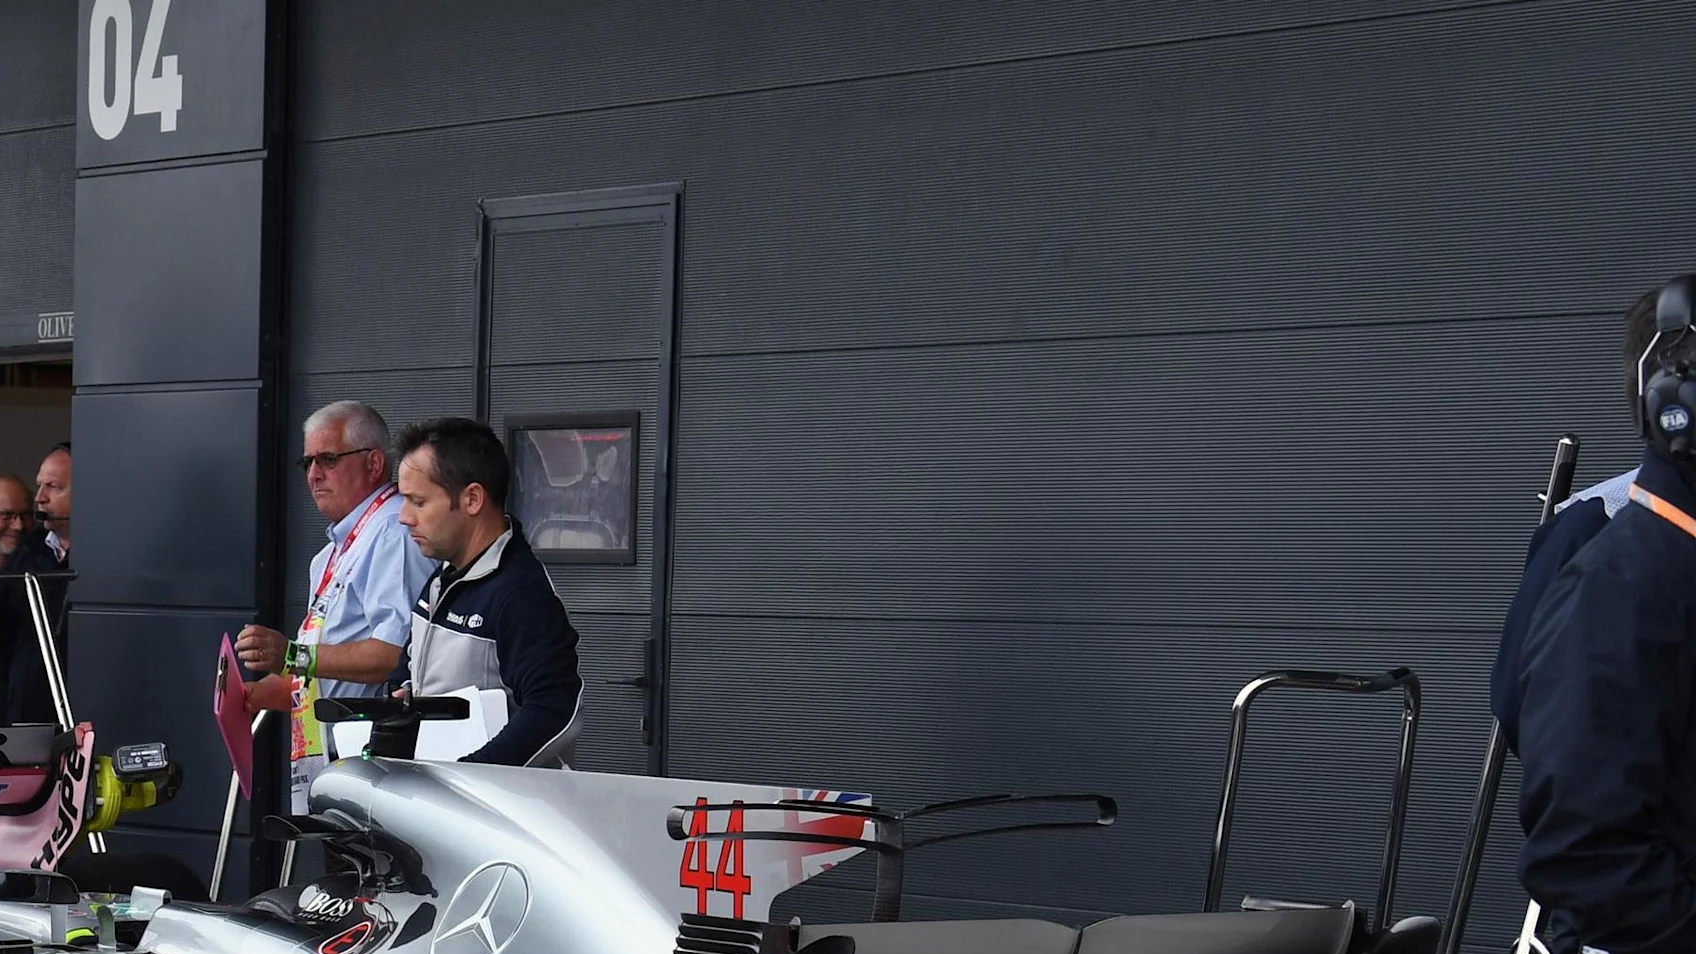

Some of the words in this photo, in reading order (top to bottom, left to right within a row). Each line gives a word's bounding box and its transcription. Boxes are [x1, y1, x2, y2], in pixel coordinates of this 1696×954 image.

[87, 0, 183, 140] 04
[38, 316, 73, 339] OLIVE
[1661, 412, 1686, 428] FIA
[679, 797, 751, 921] 44
[304, 891, 354, 917] BOSS
